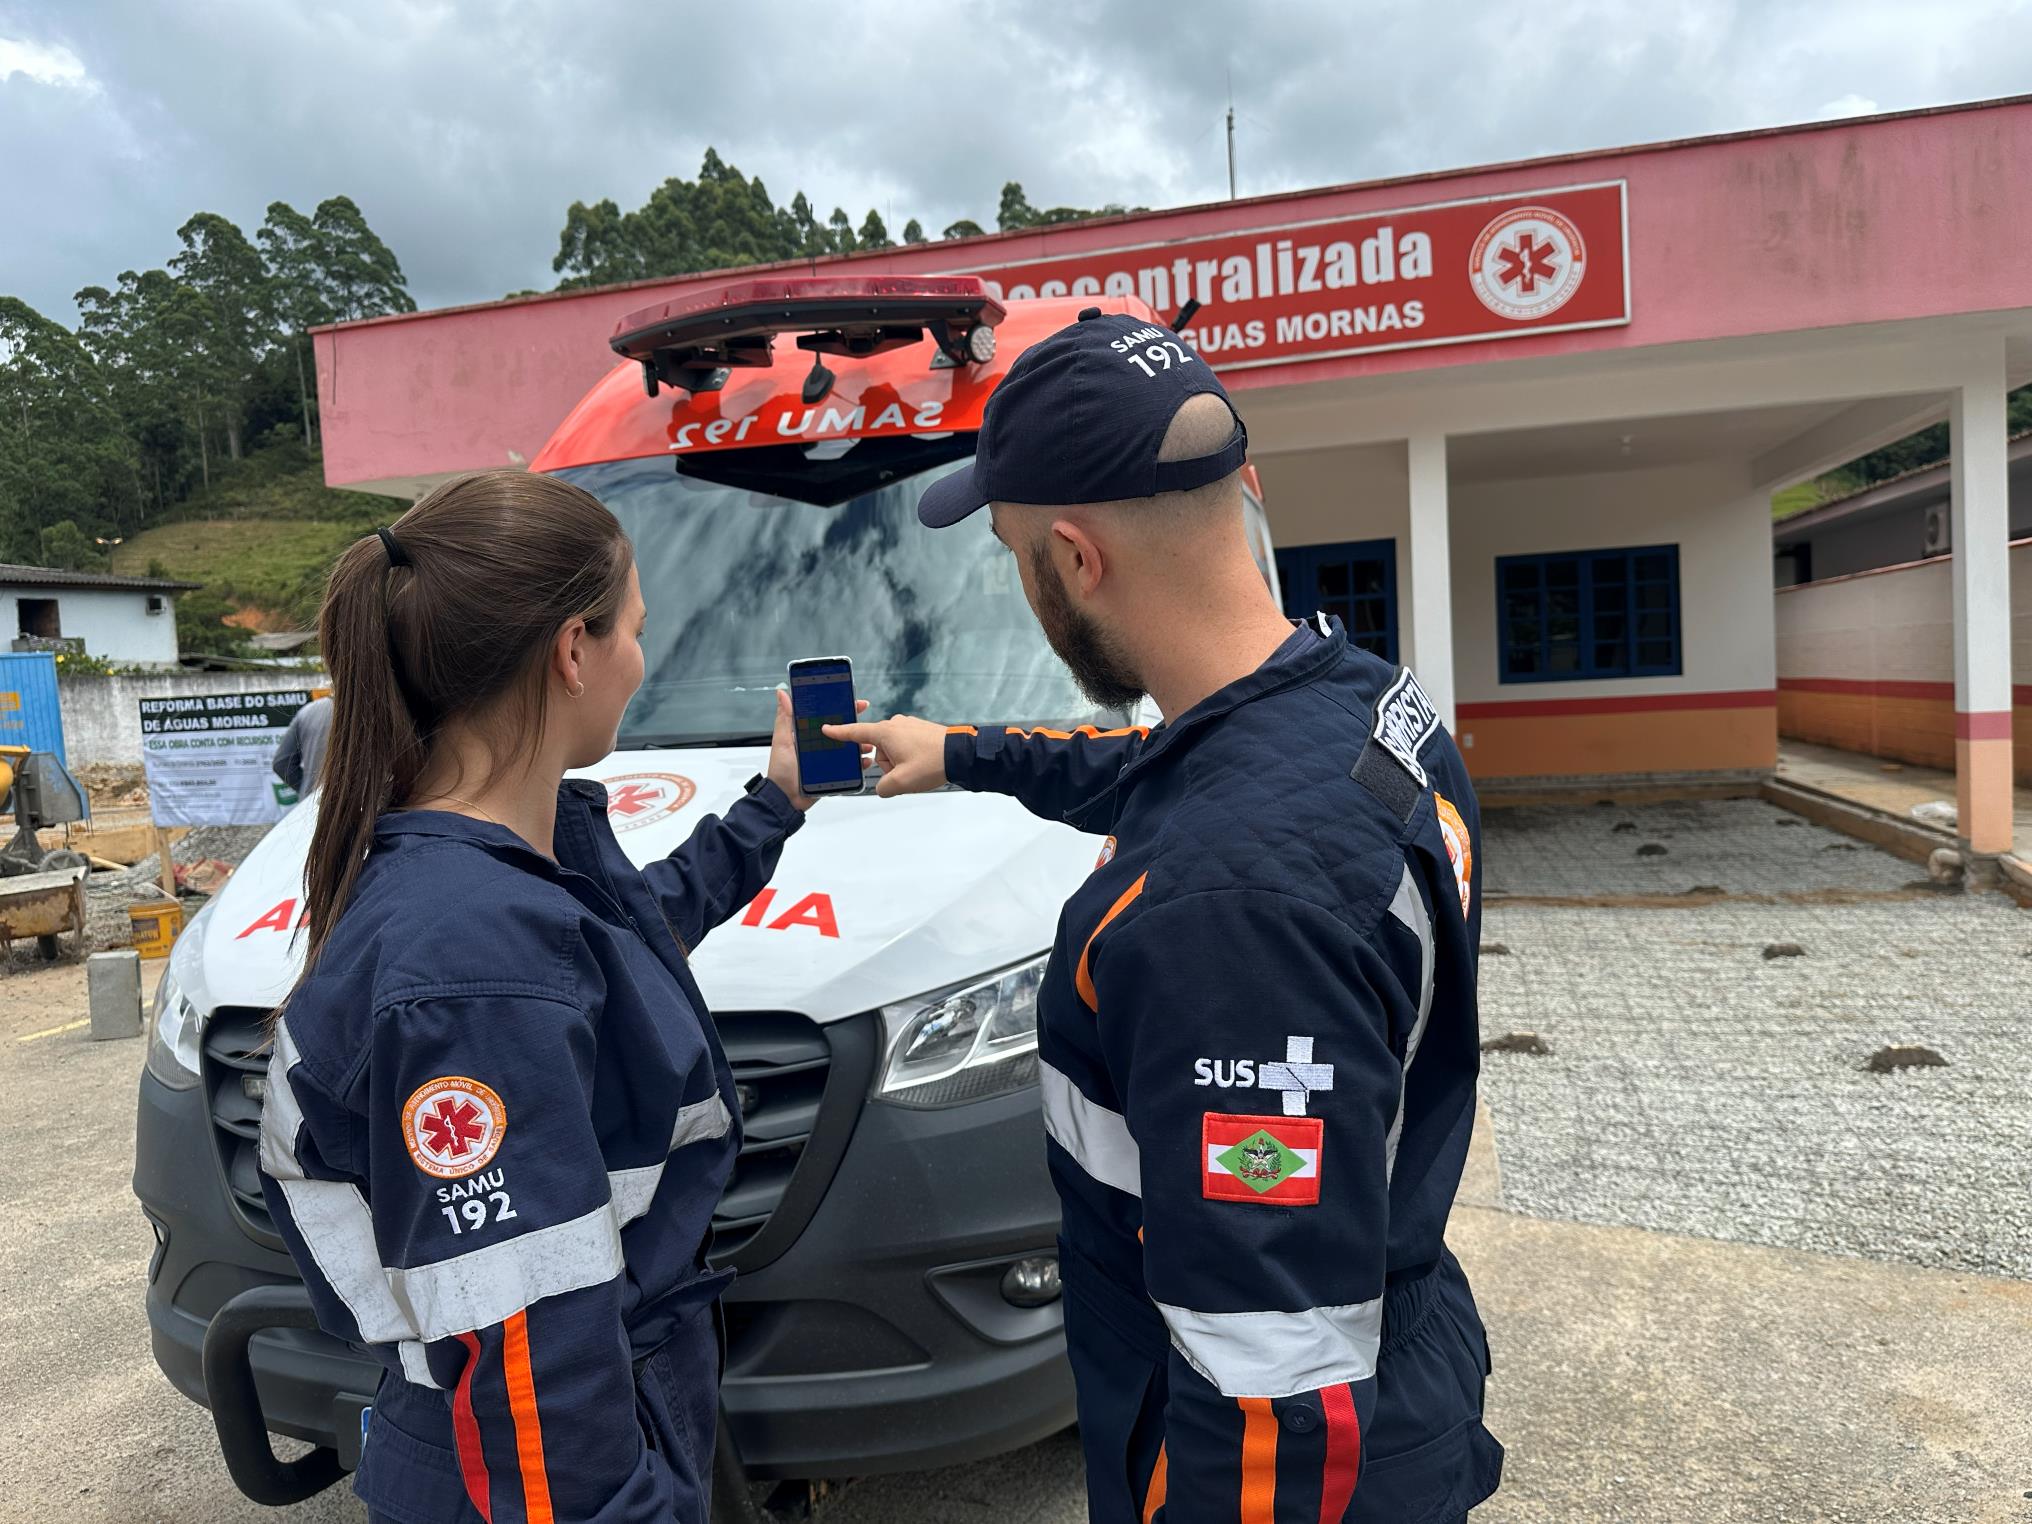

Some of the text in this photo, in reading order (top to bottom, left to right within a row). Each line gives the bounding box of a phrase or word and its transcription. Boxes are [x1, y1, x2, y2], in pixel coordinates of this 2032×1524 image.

[1110, 327, 1165, 353] SAMU
[1178, 301, 1425, 353] GUAS MORNAS
[1127, 341, 1194, 378] 192
[141, 692, 307, 714] REFORMA BASE DO SAMU
[144, 714, 269, 732] DE ÁGUAS MORNAS
[1194, 1058, 1256, 1088] SUS
[436, 1168, 505, 1203] SAMU
[442, 1191, 518, 1235] 192
